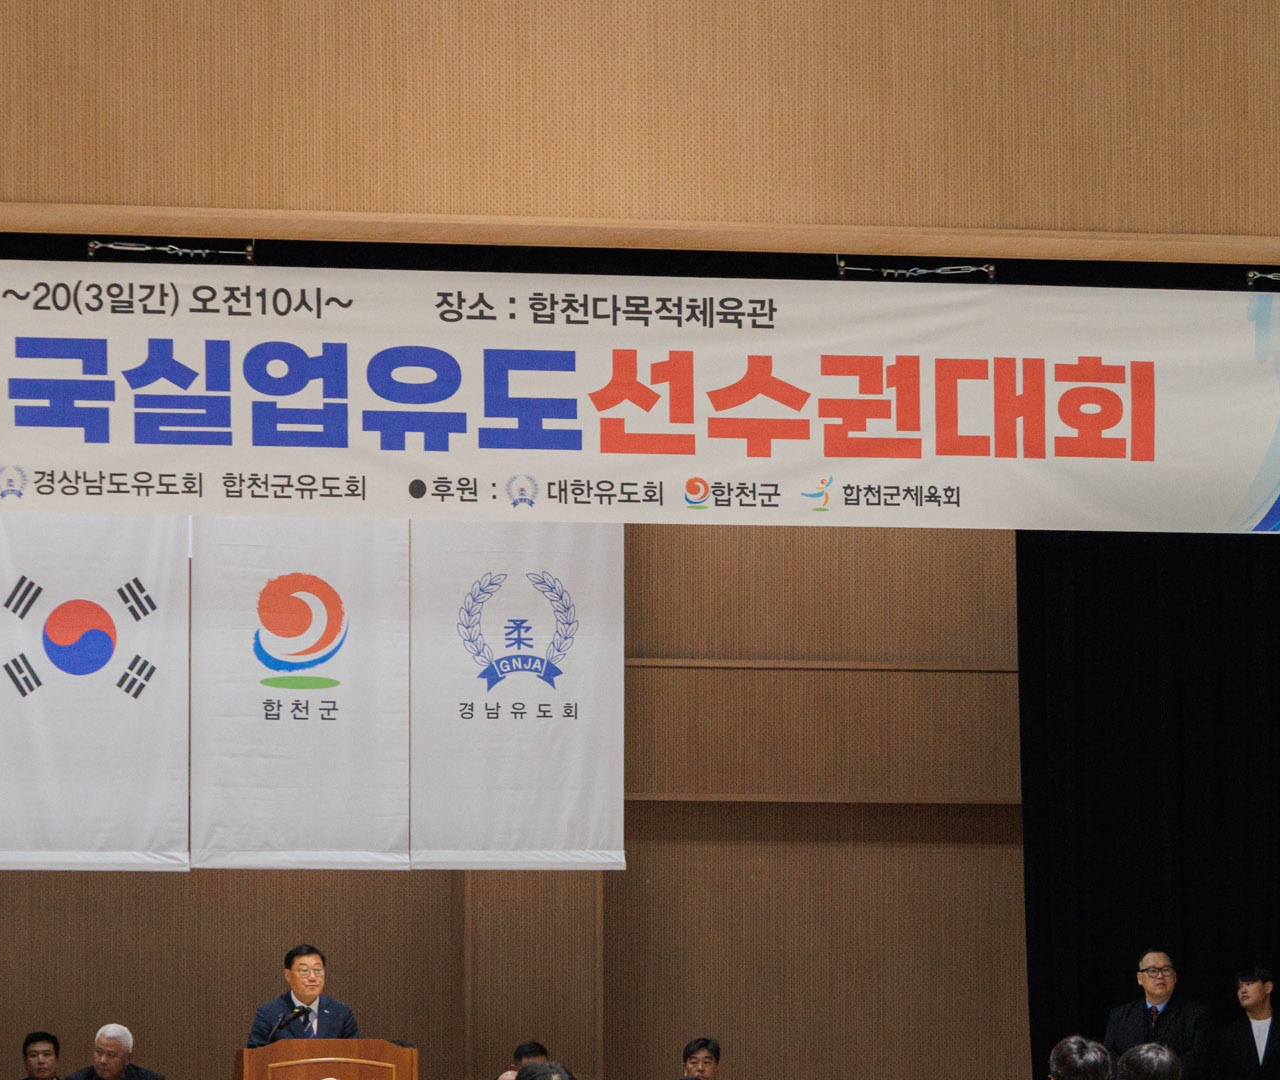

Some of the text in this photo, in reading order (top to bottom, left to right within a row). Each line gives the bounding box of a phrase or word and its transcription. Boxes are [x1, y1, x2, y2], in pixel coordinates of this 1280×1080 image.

[189, 285, 354, 319] 오전10시~
[434, 290, 497, 323] 장소
[528, 292, 778, 330] 합천다목적체육관
[33, 469, 203, 498] 경상남도유도회
[222, 472, 366, 501] 합천군유도회
[547, 479, 664, 507] 대한유도회
[710, 481, 781, 508] 합천군
[842, 483, 960, 508] 합천군체육회
[503, 618, 534, 651] 柔
[499, 656, 542, 673] GNJA
